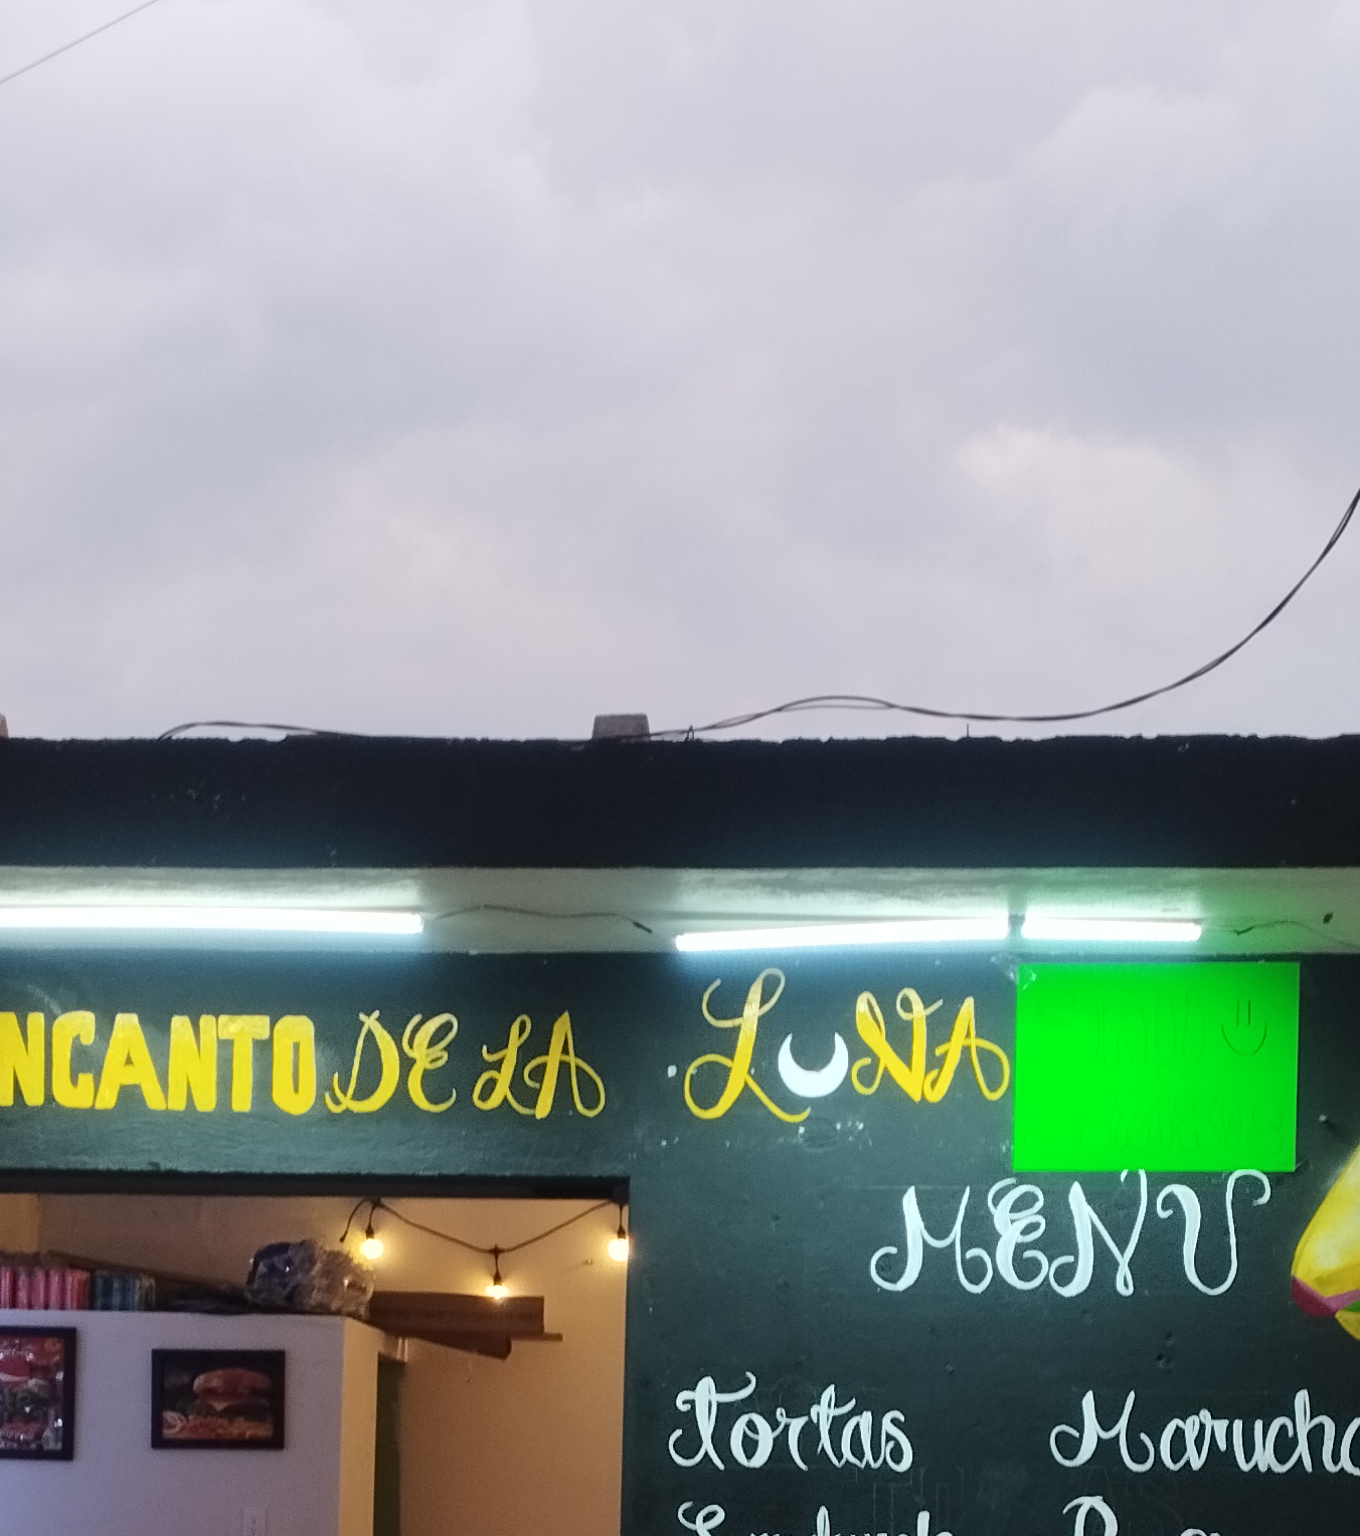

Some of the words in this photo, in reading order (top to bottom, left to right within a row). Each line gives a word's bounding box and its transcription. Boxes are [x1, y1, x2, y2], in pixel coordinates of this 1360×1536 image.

[325, 1010, 457, 1114] DE
[472, 1011, 605, 1118] LA
[684, 968, 1010, 1122] LUNA
[871, 1169, 1272, 1297] MENU
[669, 1372, 914, 1473] Tortas
